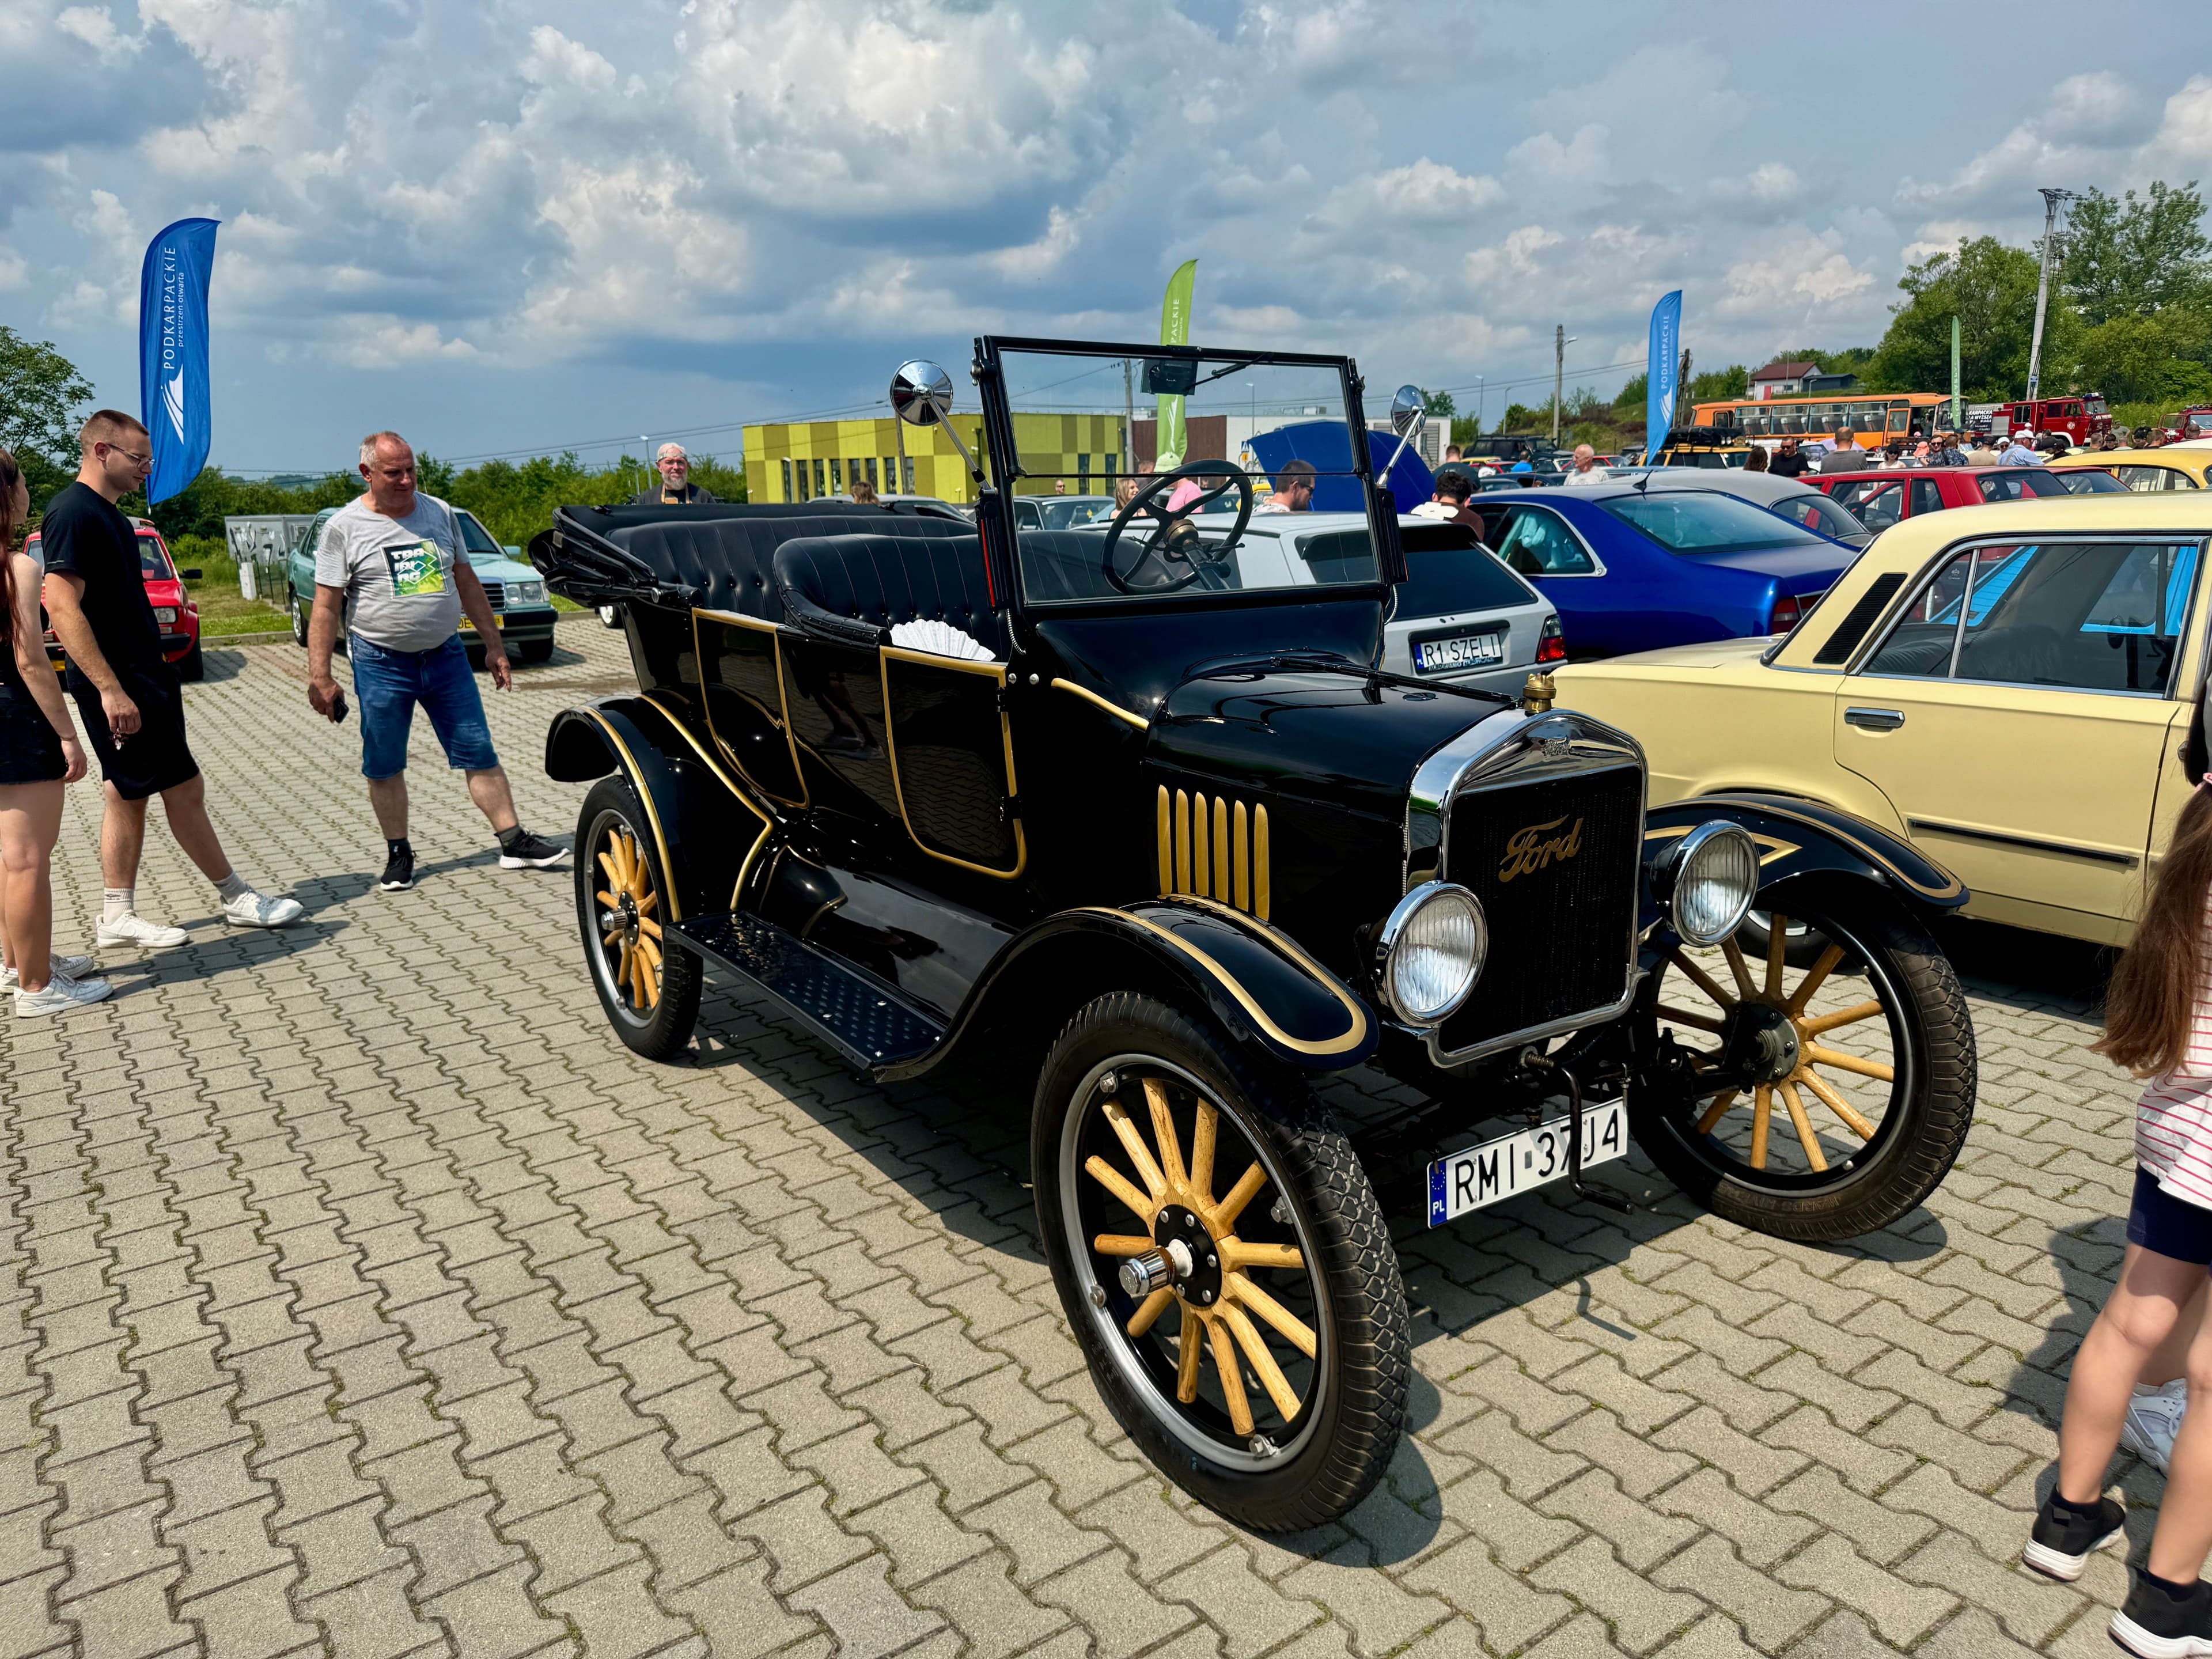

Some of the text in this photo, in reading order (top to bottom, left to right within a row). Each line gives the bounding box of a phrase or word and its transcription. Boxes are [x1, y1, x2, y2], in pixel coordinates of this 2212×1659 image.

[164, 247, 176, 369] PODKARPACKIE
[1171, 299, 1179, 343] PACKIE
[1661, 315, 1669, 389] PODKARPACKIE
[391, 548, 424, 559] TRA
[1425, 643, 1444, 665] R1
[1499, 814, 1584, 882] Ford
[1433, 1200, 1445, 1215] PL
[1455, 1143, 1514, 1210] RMI
